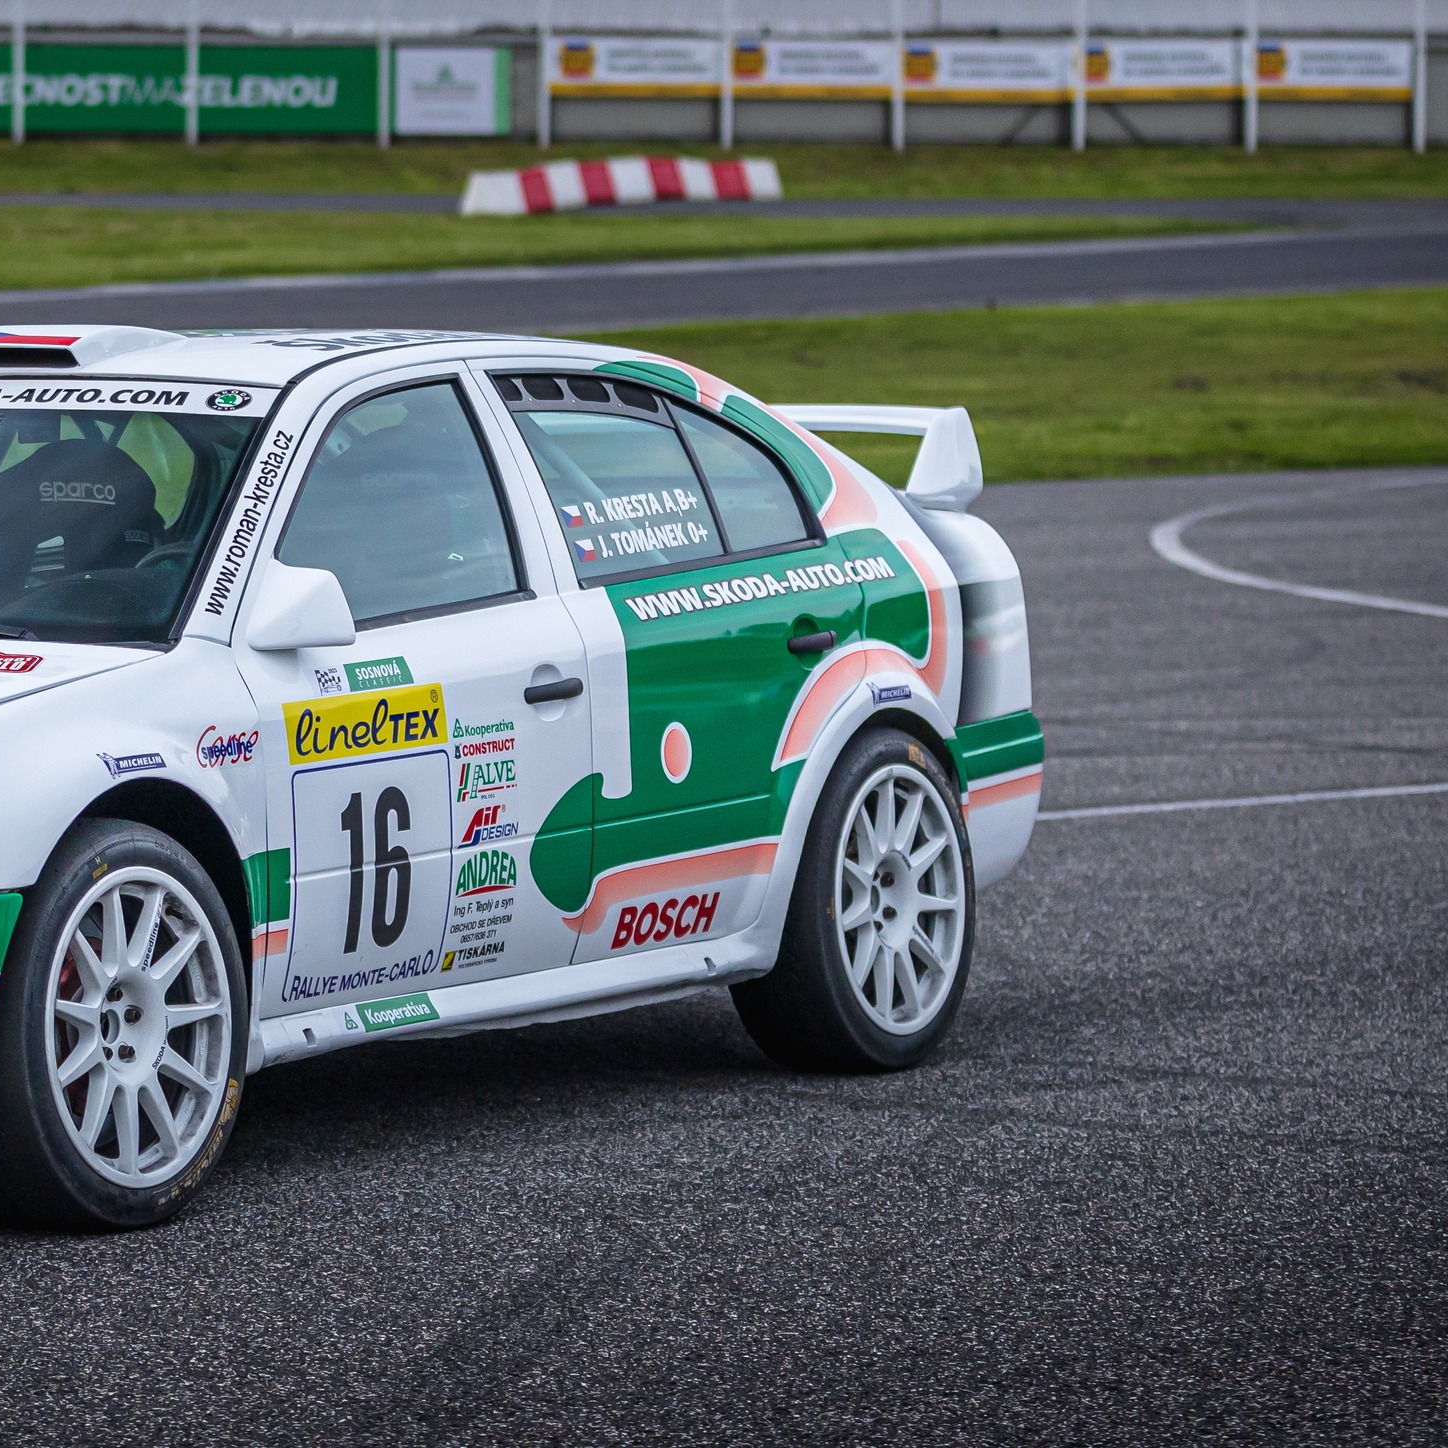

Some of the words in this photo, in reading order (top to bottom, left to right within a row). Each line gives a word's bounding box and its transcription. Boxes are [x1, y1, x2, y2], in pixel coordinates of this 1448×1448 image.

[39, 481, 116, 502] sparco
[583, 501, 605, 525] R.
[601, 492, 664, 522] KRESTA
[204, 430, 294, 616] www.roman-kresta.cz
[598, 535, 614, 559] J.
[610, 521, 690, 556] TOMÁNEK
[625, 556, 896, 621] WWW.SKODA-AUTO.COM
[355, 660, 402, 681] SOSNOVÁ
[359, 675, 404, 689] CLASSIC
[882, 687, 910, 699] MICHELIN
[464, 719, 515, 738] Kooperativa
[201, 738, 253, 764] speedline
[462, 738, 516, 757] CONSTRUCT
[118, 754, 163, 769] MICHELIN
[481, 822, 519, 841] DESIGN
[340, 786, 411, 955] 16
[455, 849, 517, 896] ANDREA
[475, 899, 494, 914] Teplý
[494, 900, 500, 909] a
[501, 897, 514, 910] syn
[450, 920, 477, 934] OBCHOD
[477, 919, 487, 929] SE
[610, 891, 721, 950] BOSCH
[141, 922, 159, 972] speedline
[457, 941, 505, 961] TISKÁRNA
[289, 974, 338, 1002] RALLYE
[339, 949, 435, 991] MONTE-CARLO
[364, 1000, 431, 1025] Kooperativa
